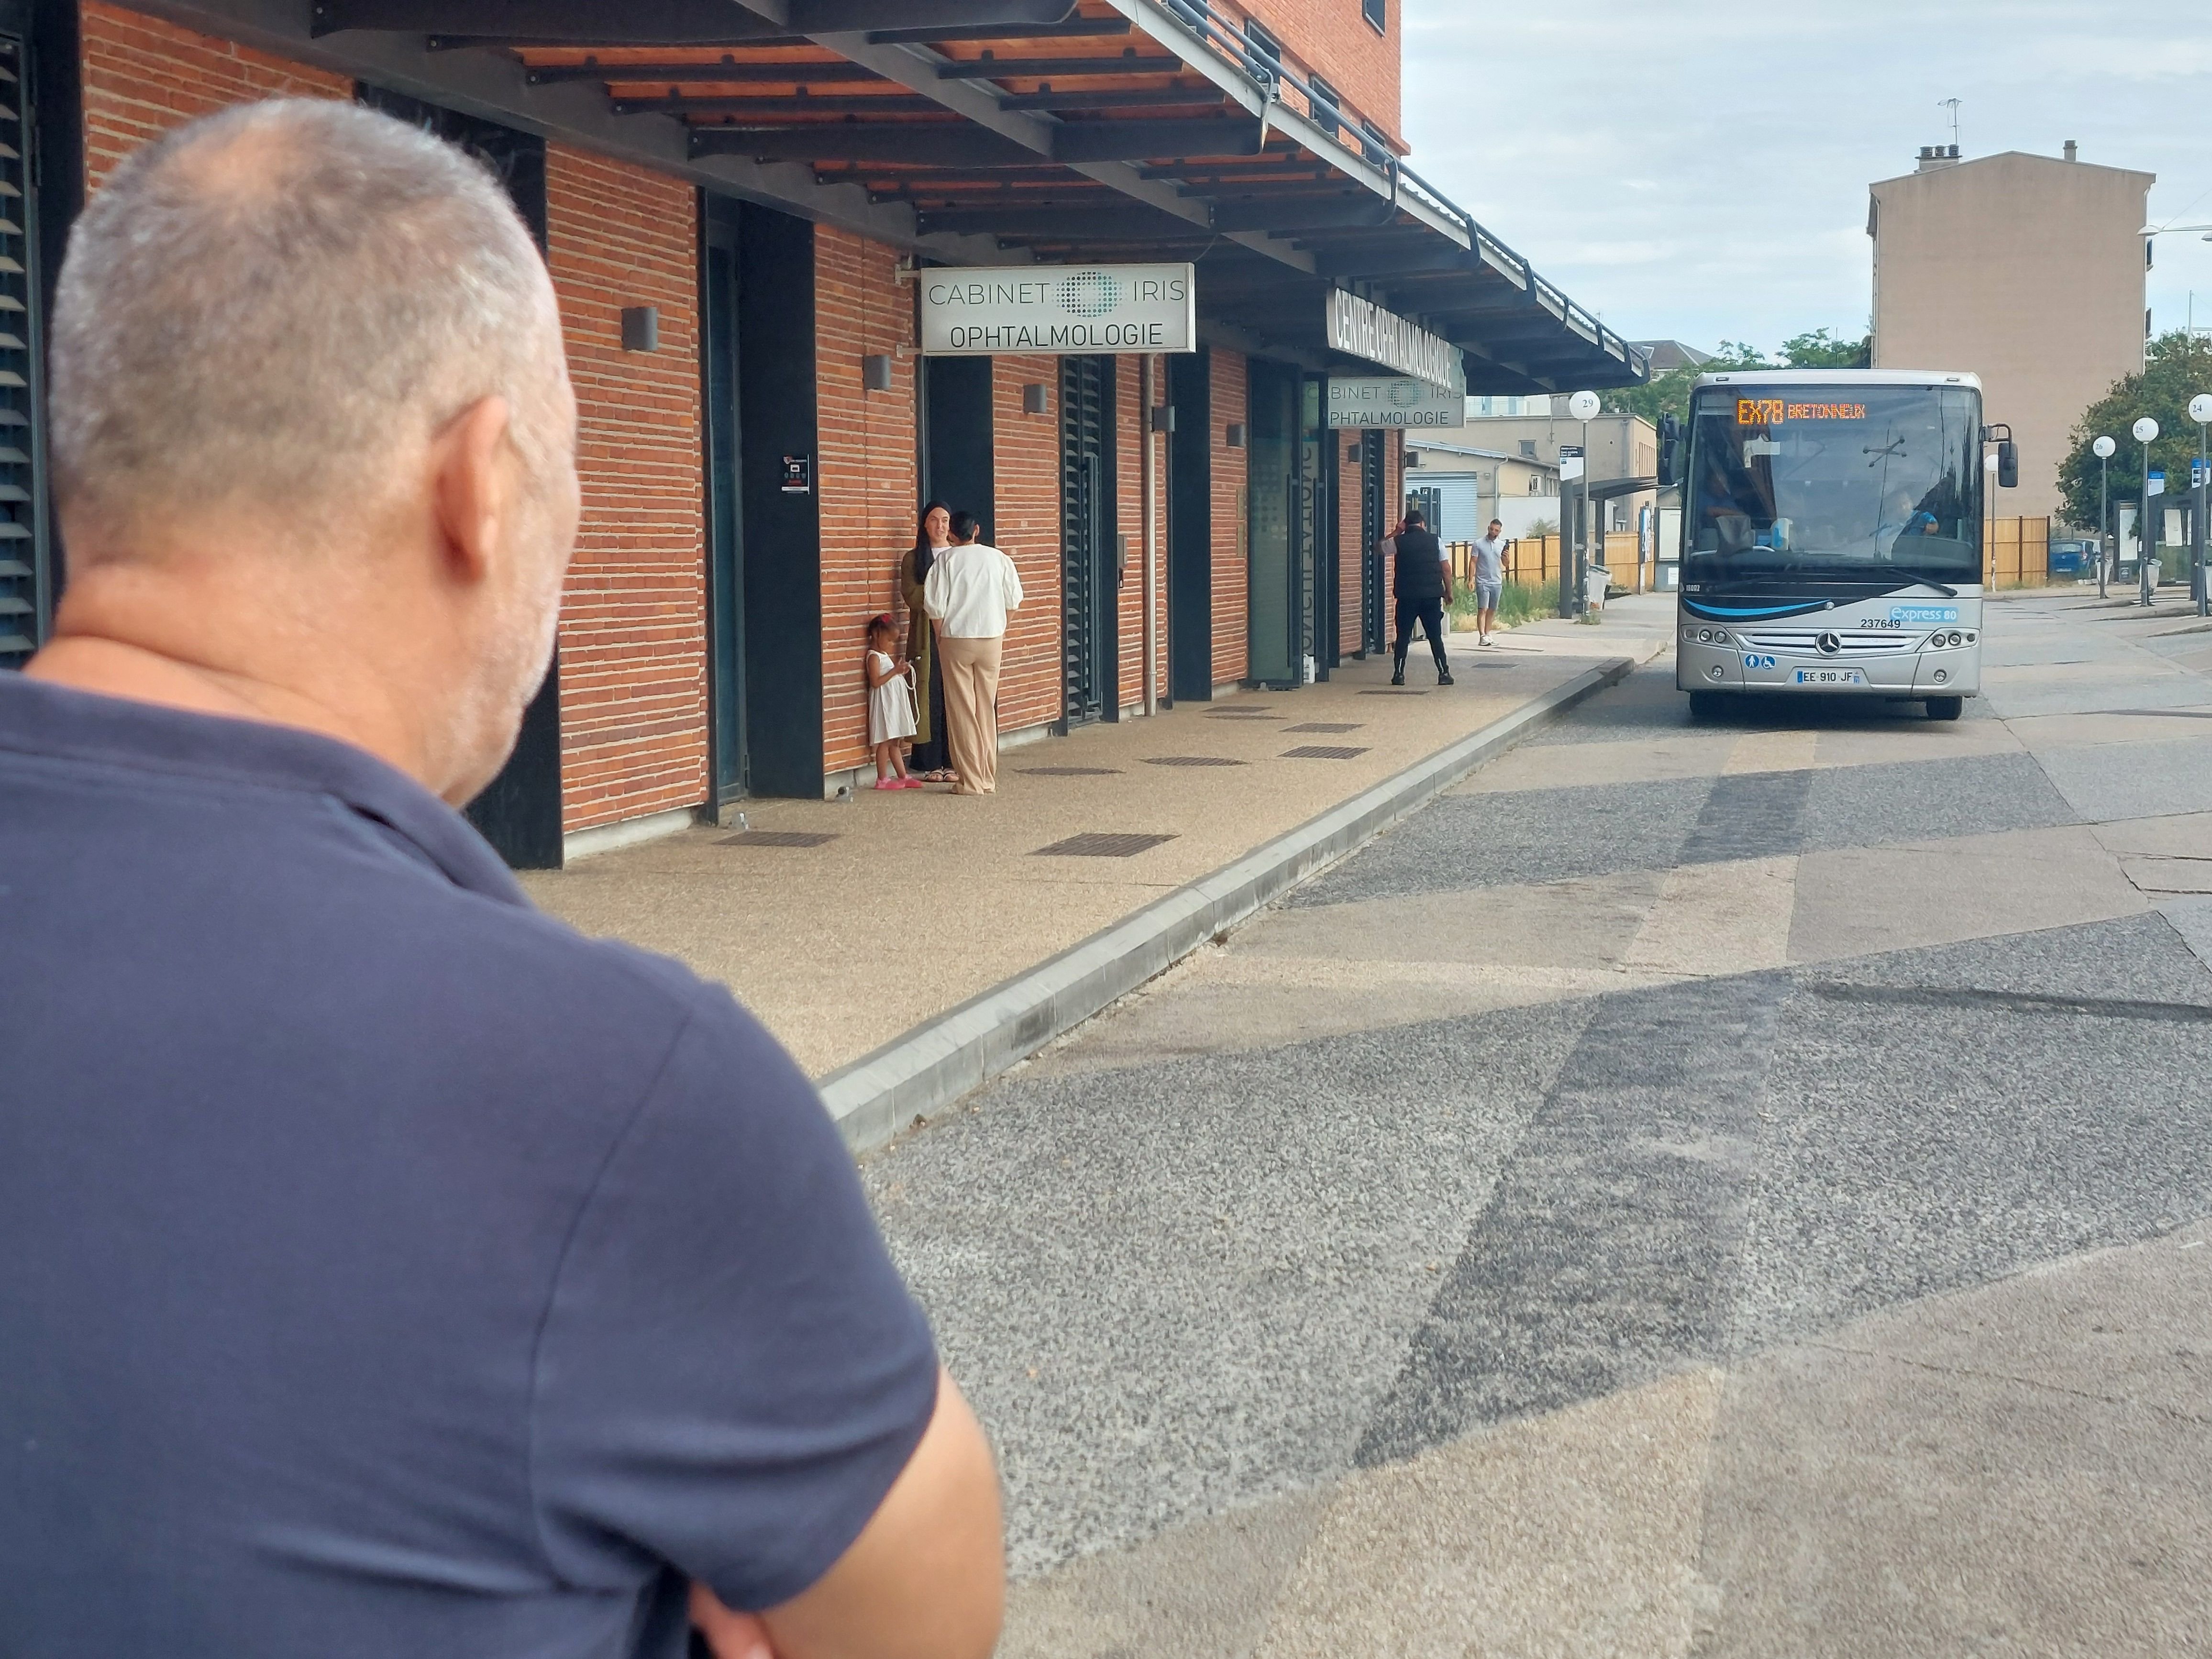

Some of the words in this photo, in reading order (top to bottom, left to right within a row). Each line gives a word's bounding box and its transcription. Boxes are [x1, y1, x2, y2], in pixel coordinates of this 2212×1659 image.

[929, 282, 1051, 305] CABINET
[1133, 280, 1185, 302] IRIS
[951, 323, 1163, 348] OPHTALMOLOGIE
[1335, 287, 1376, 358] CENTRE
[1375, 305, 1452, 389] OPHTALMOLOGIQUE
[1582, 399, 1593, 408] 29
[2192, 404, 2203, 413] 24
[1330, 411, 1449, 425] PHTALMOLOGIE
[2135, 426, 2144, 434] 25
[1891, 607, 1942, 622] express
[1944, 610, 1957, 620] 80
[1860, 619, 1901, 628] 237649
